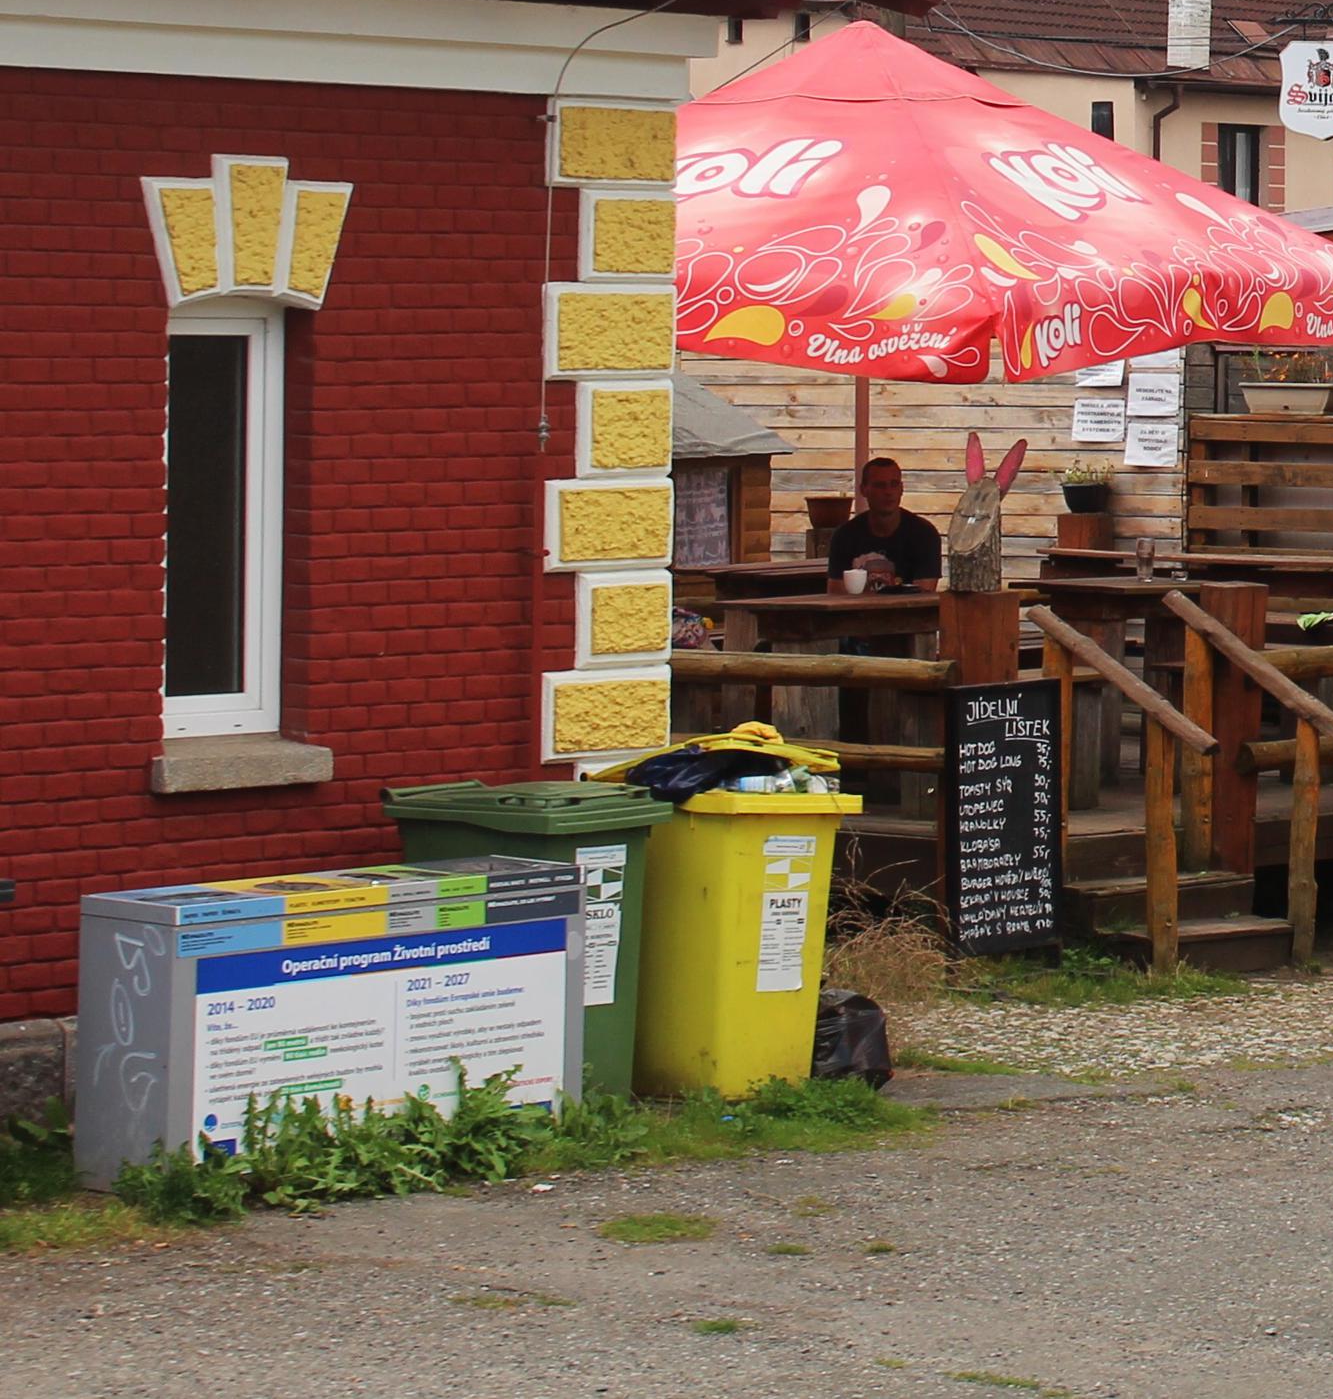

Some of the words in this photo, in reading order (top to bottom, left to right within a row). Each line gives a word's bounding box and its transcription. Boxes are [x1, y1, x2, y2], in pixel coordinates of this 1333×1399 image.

[675, 138, 843, 200] oli
[988, 143, 1144, 221] Koli
[807, 333, 864, 365] Vlna
[867, 323, 958, 361] osvěžení
[1034, 303, 1082, 368] Koli
[966, 693, 1022, 722] JÍDELNÍ
[959, 743, 976, 758] HOT
[977, 740, 996, 755] DOG
[959, 760, 976, 774] HOT
[977, 757, 998, 770] DOG
[1000, 755, 1022, 769] LONG
[959, 782, 992, 799] TOASTY
[959, 799, 1005, 816] UTOPENEC
[769, 898, 803, 909] PLASTY
[586, 908, 615, 921] SKLO
[281, 954, 337, 977] Operační
[339, 950, 391, 970] program
[393, 941, 436, 961] Životní
[436, 935, 492, 959] prostředí
[406, 977, 432, 992] 2021
[444, 972, 471, 987] 2027
[207, 1001, 235, 1016] 2014
[246, 996, 276, 1011] 2020
